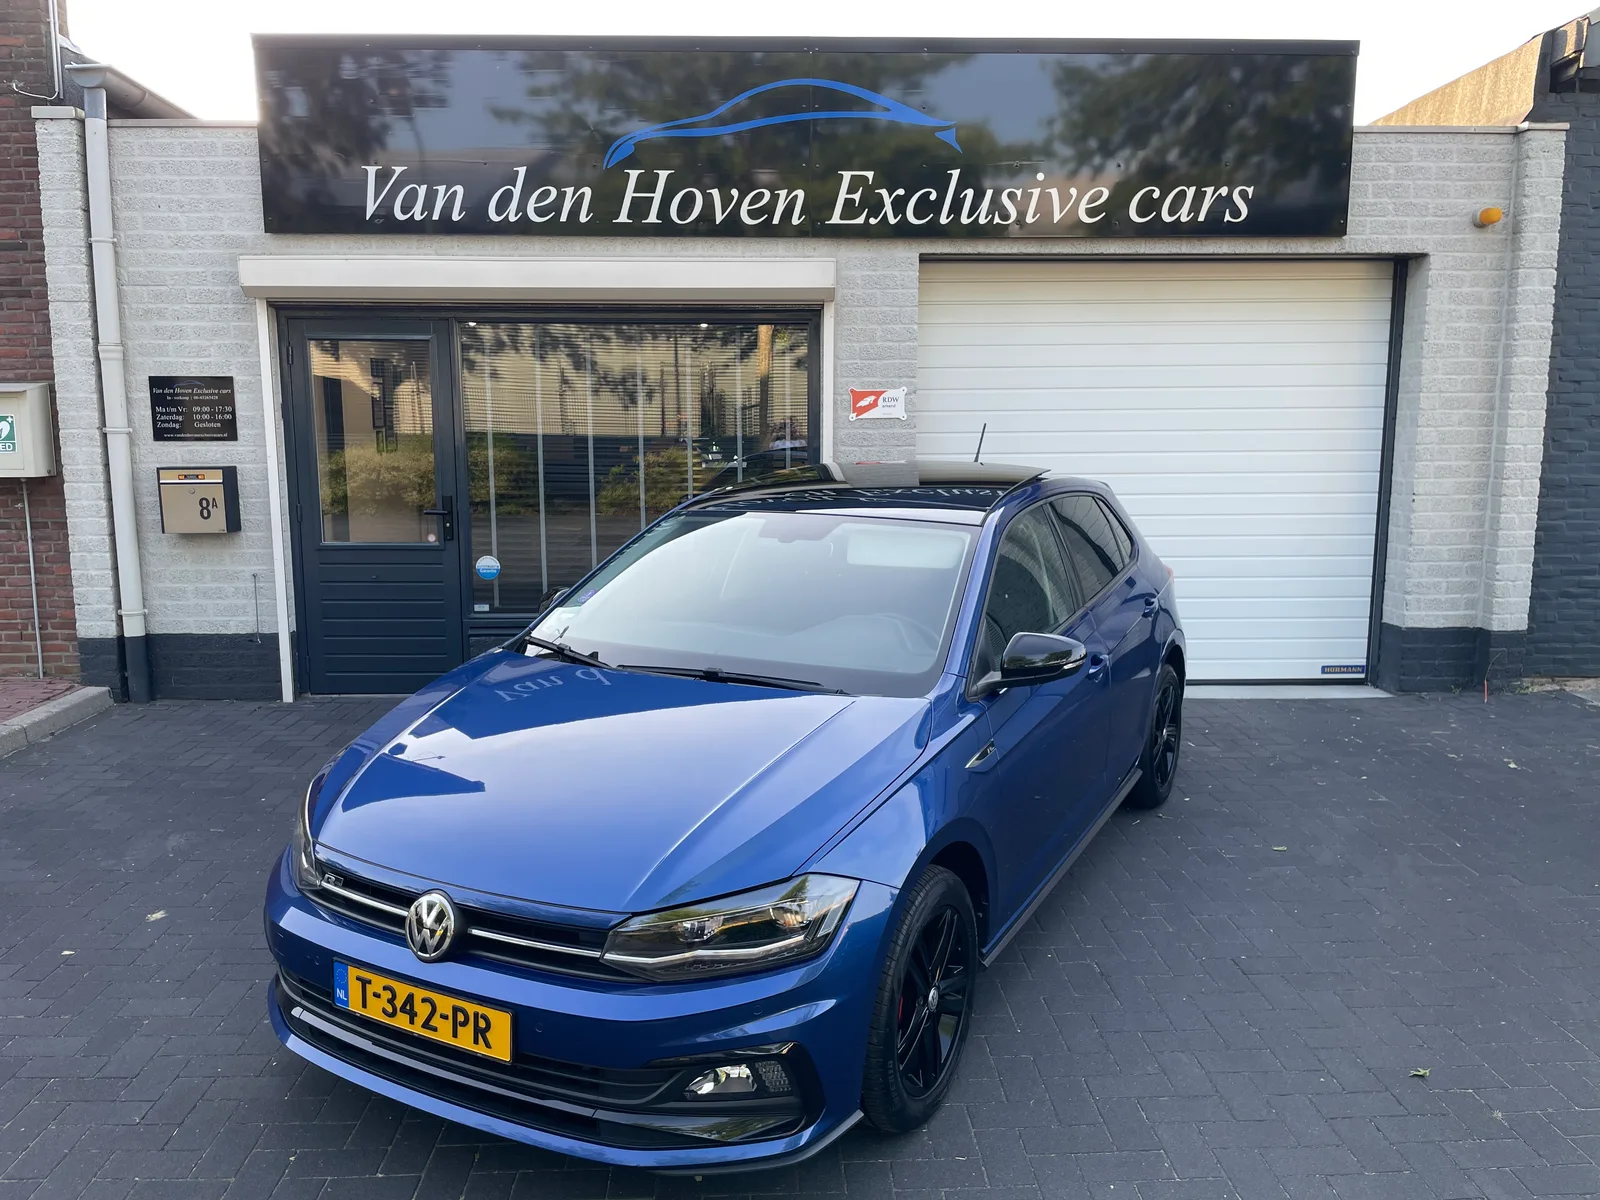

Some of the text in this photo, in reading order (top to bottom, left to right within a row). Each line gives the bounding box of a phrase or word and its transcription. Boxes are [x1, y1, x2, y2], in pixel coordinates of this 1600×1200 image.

[361, 165, 1255, 226] Van den Hoven Exclusive cars
[156, 413, 185, 421] Zaterdag:
[156, 421, 182, 429] Zondag:
[0, 443, 13, 451] ED
[336, 988, 347, 1001] NL
[355, 975, 493, 1049] T-342-PR
